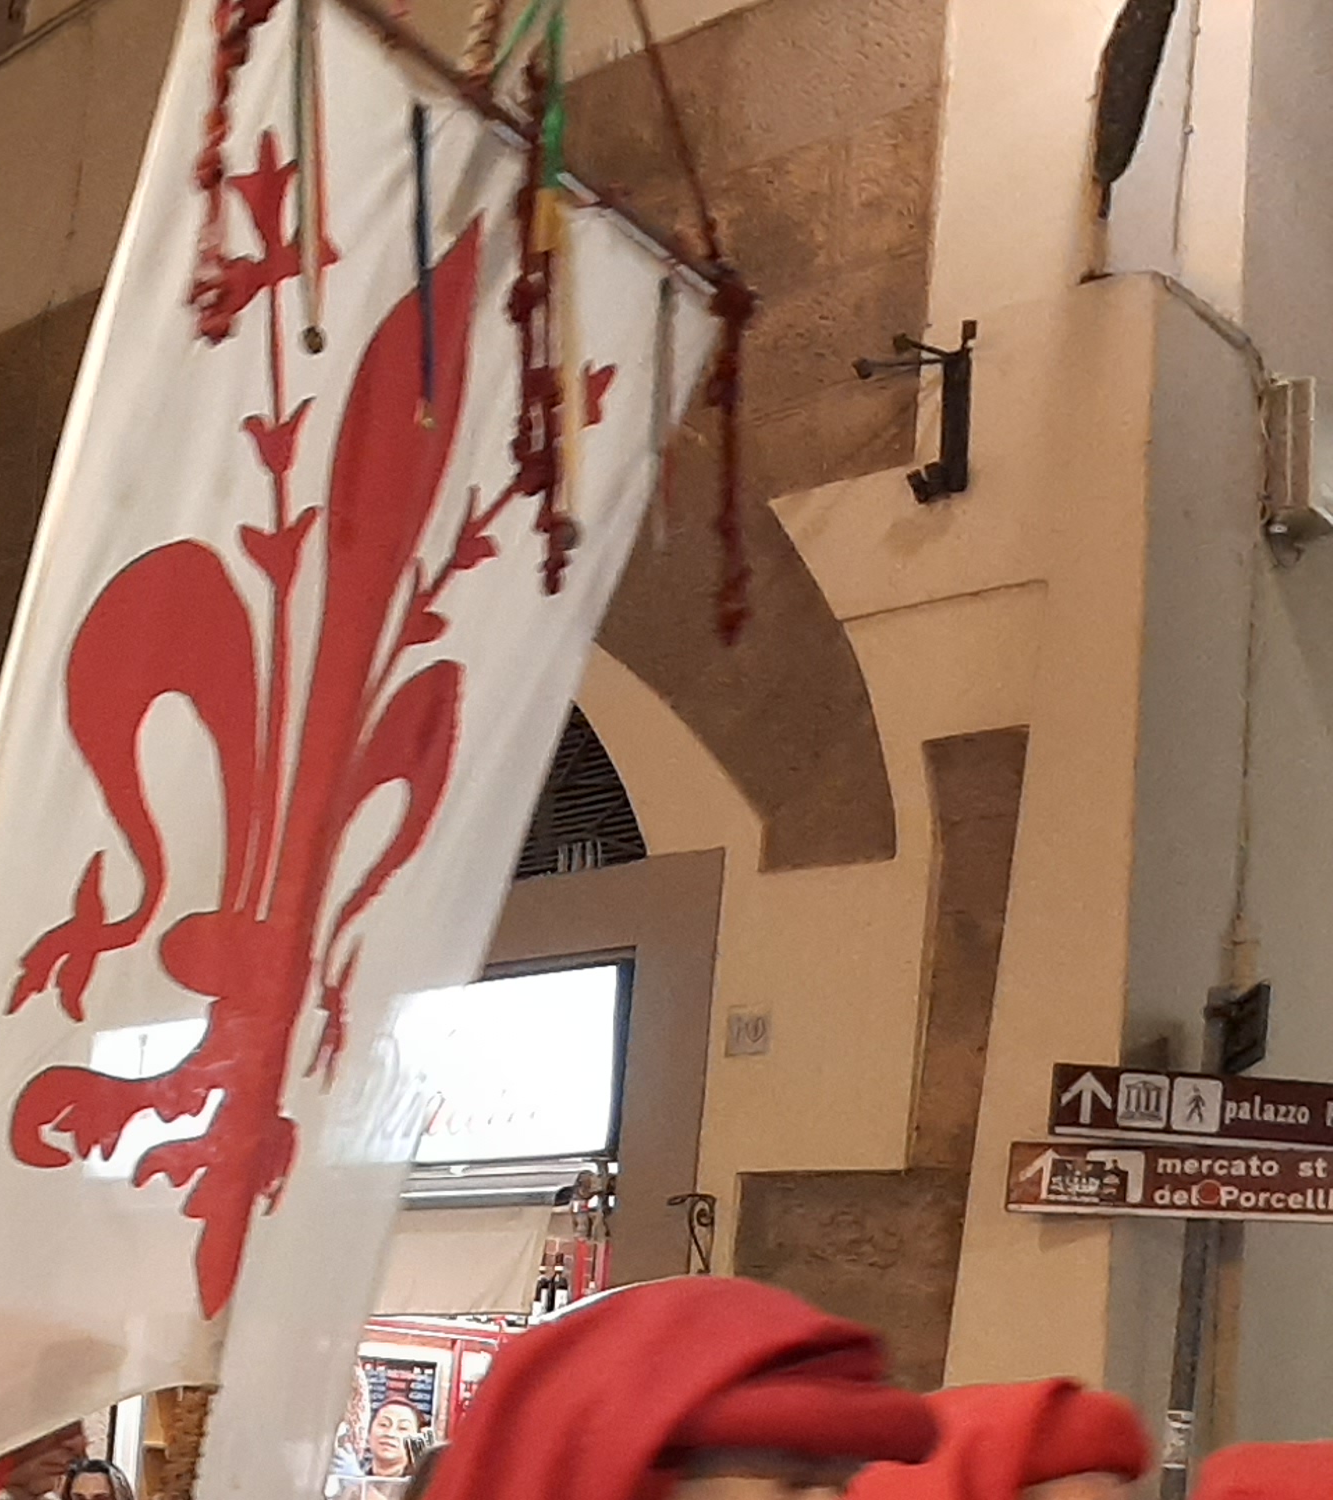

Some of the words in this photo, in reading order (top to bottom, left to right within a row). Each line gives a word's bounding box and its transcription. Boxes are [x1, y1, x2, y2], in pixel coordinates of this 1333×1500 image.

[1224, 1095, 1310, 1124] palazzo
[1156, 1155, 1280, 1177] mercato
[1153, 1184, 1200, 1206] del
